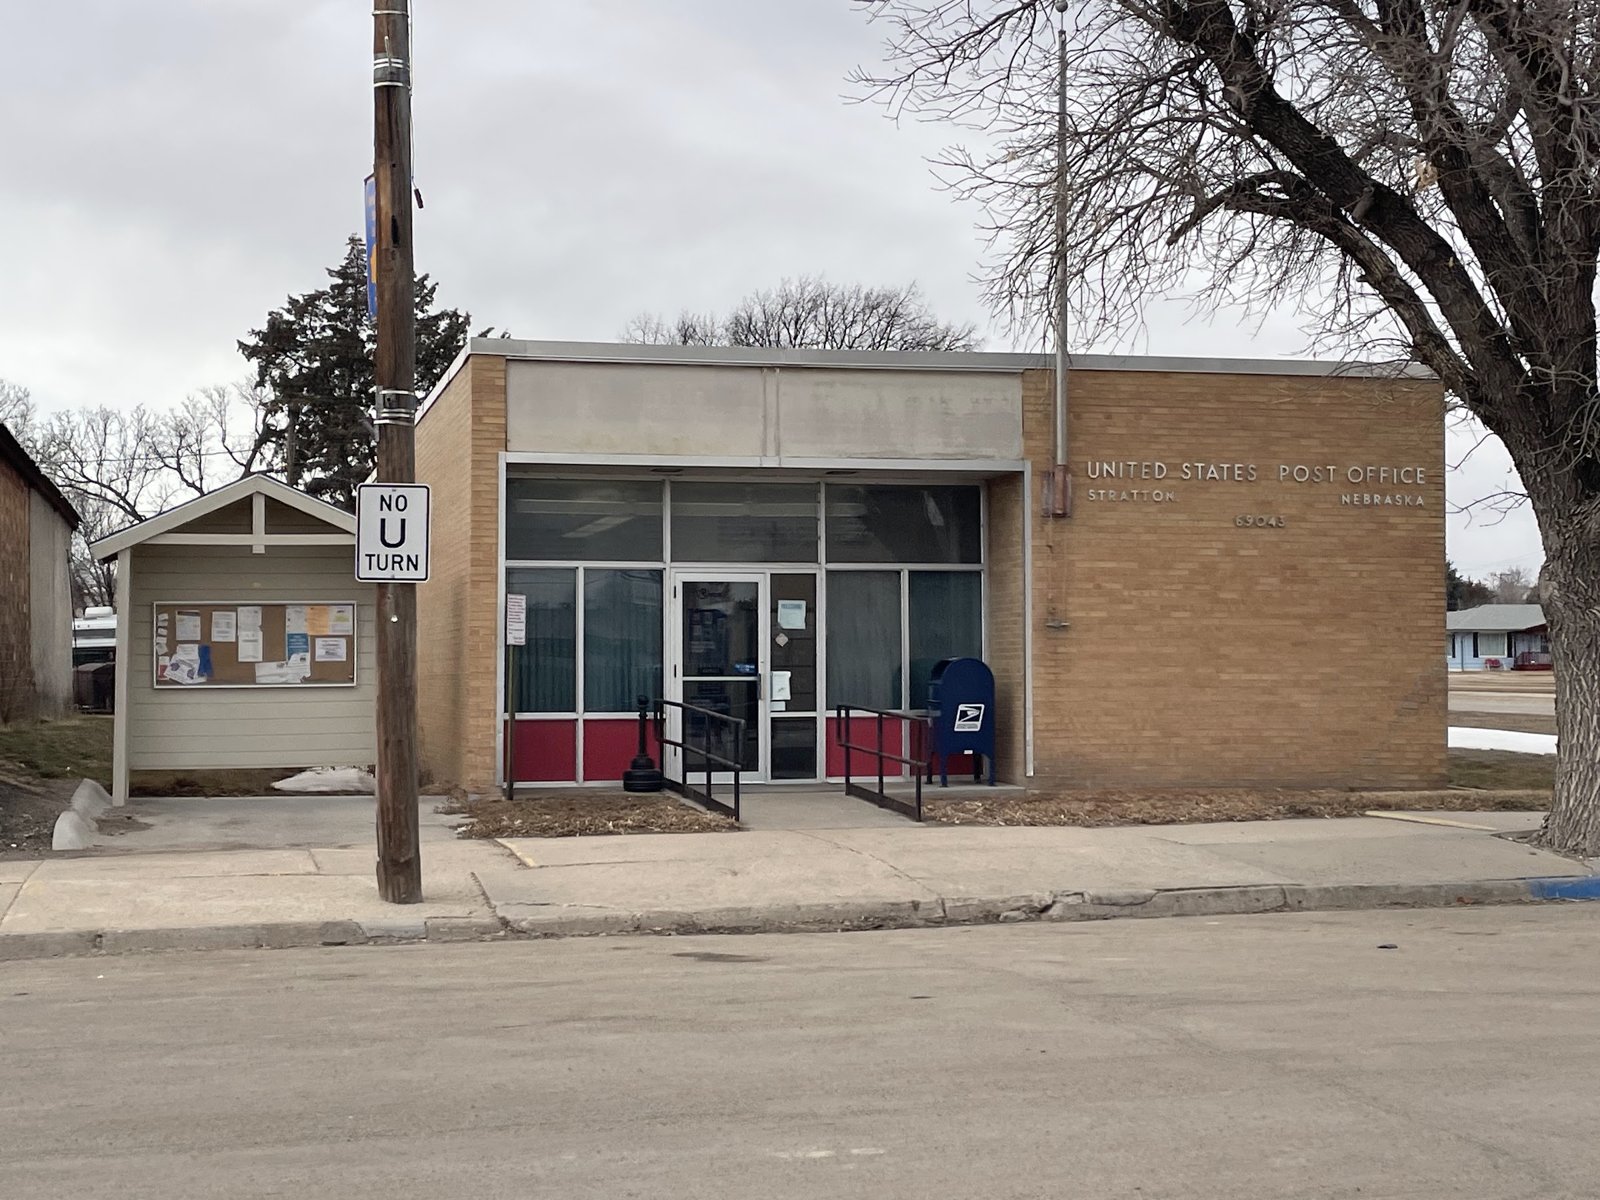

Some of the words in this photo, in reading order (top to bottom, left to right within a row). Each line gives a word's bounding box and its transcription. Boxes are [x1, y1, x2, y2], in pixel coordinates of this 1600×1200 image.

[1087, 461, 1167, 480] UNITED
[1181, 462, 1258, 481] STATES
[1279, 464, 1337, 483] POST
[1347, 466, 1427, 485] OFFICE
[379, 494, 408, 512] NO
[1087, 488, 1177, 502] STRATTON
[1341, 493, 1426, 507] NEBRASKA
[1235, 514, 1286, 528] 69043
[380, 518, 406, 549] U
[364, 553, 419, 571] TURN
